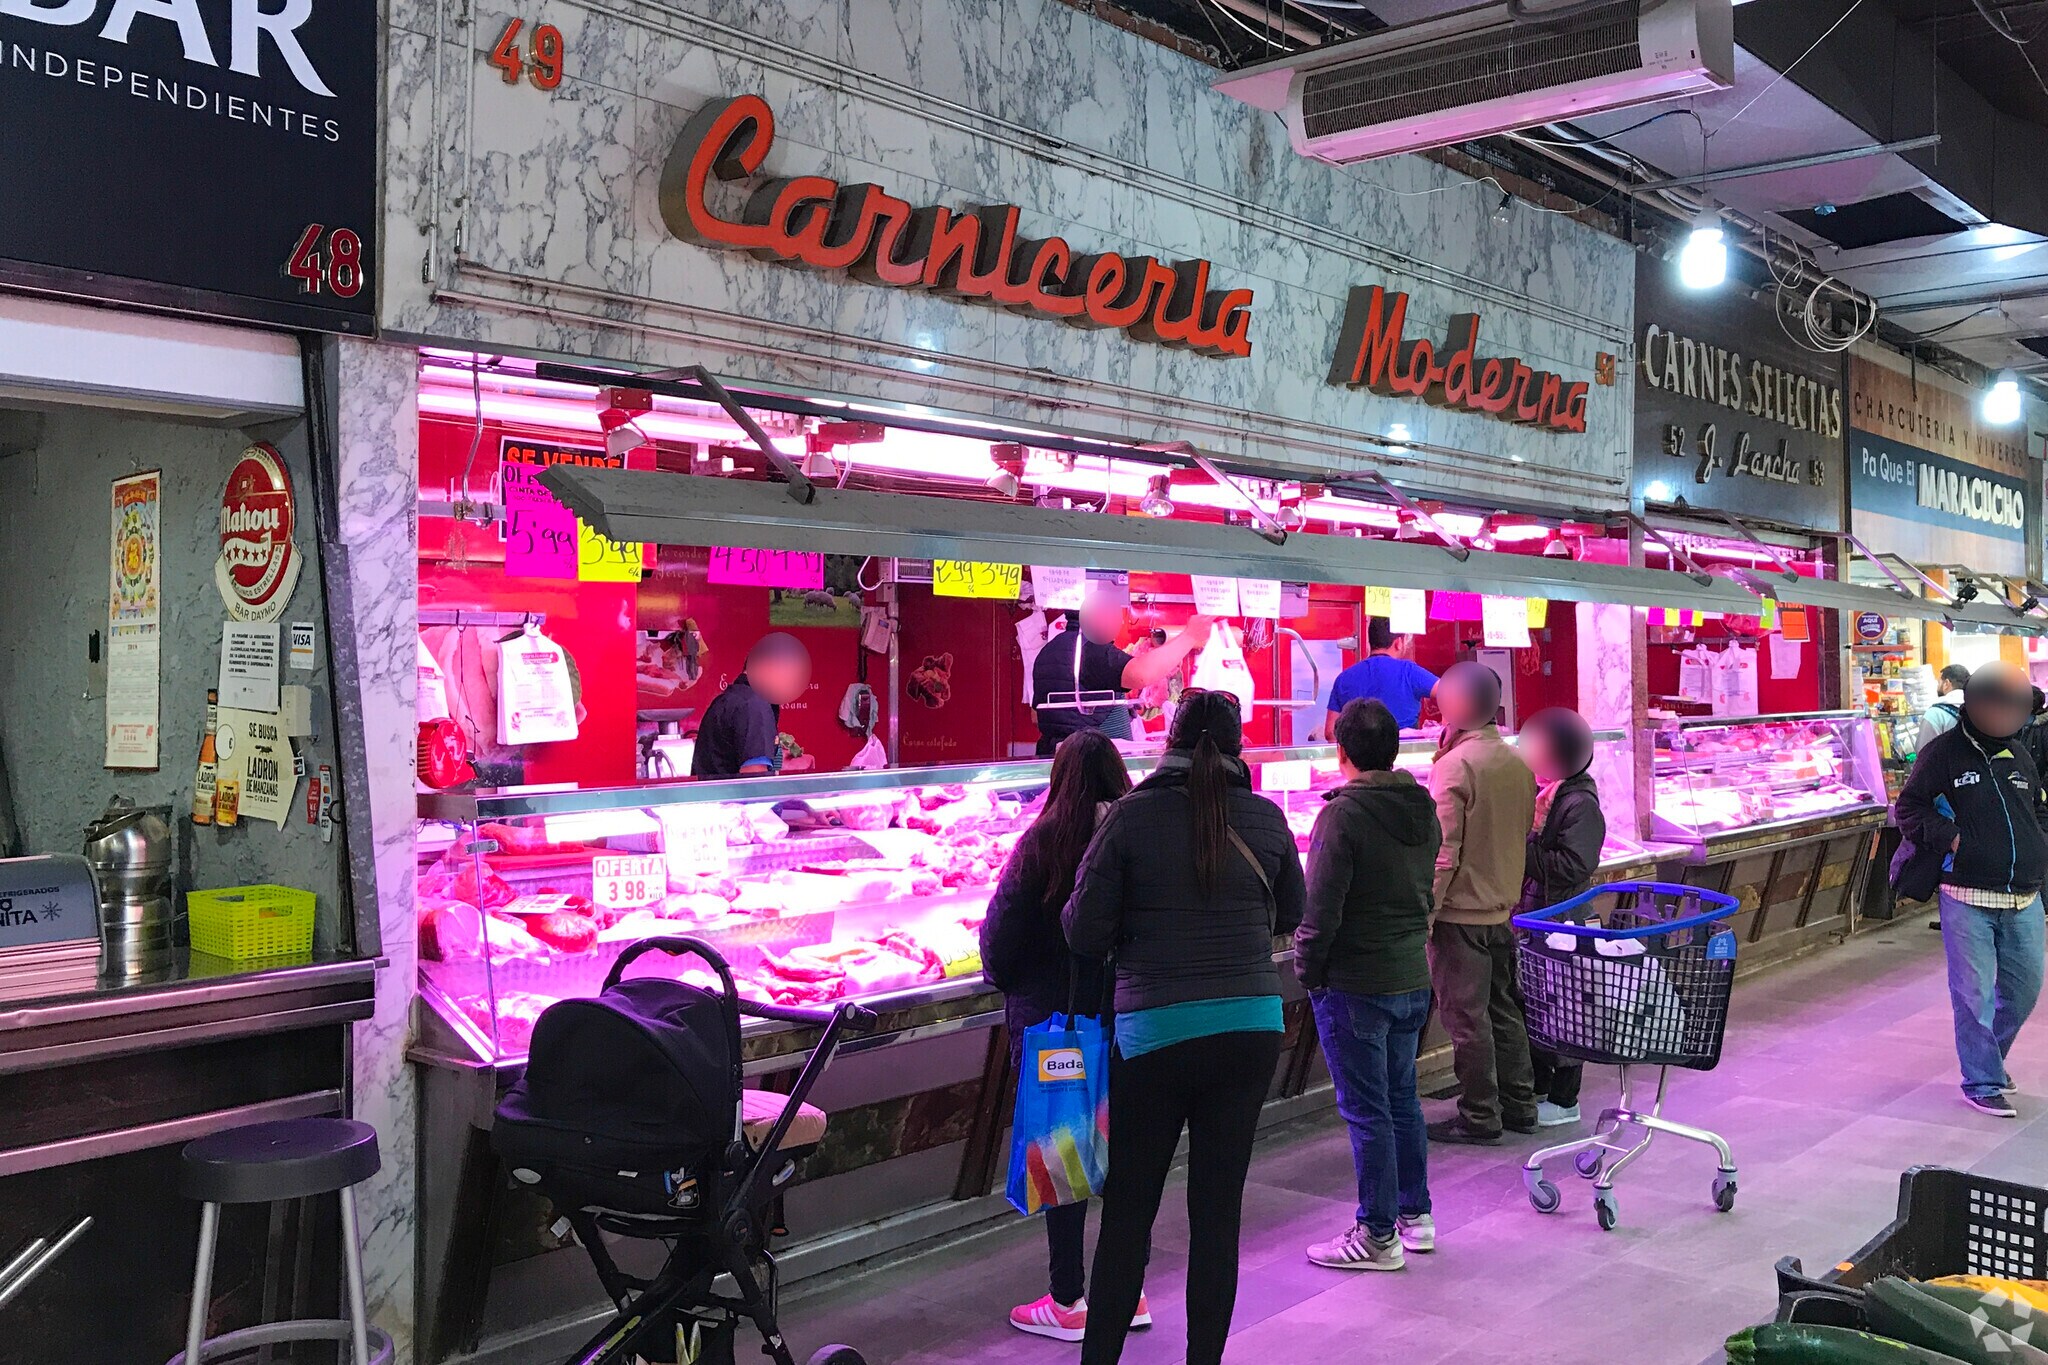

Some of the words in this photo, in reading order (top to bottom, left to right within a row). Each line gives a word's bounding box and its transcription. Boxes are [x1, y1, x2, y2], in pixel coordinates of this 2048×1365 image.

[491, 18, 563, 90] 49
[286, 223, 362, 298] 48
[662, 94, 1254, 358] Carniceria
[1330, 285, 1589, 433] Moderna
[1644, 323, 1743, 410] CARNES
[1751, 359, 1842, 439] SELECTAS
[1854, 392, 1957, 447] CHARCUTERIA
[1964, 429, 1970, 450] Y
[1975, 434, 2024, 468] VIVERES
[1666, 424, 1687, 457] 52
[1696, 423, 1724, 484] J.
[1729, 431, 1800, 485] Lancha
[1811, 458, 1826, 487] 53
[1862, 447, 1877, 477] Pa
[1879, 452, 1904, 484] Que
[1906, 460, 1915, 487] El
[1918, 463, 2024, 530] MARACUCHO
[221, 502, 280, 534] Mahou
[512, 510, 576, 555] 5'99
[234, 603, 250, 620] BAR
[251, 601, 276, 622] DAYMO
[293, 633, 311, 646] VISA
[248, 722, 257, 738] SE
[258, 724, 278, 742] BUSCA
[246, 778, 252, 793] DE
[252, 781, 279, 798] MANZANAS
[596, 858, 664, 877] OFERTA
[1047, 1059, 1084, 1071] Bada
